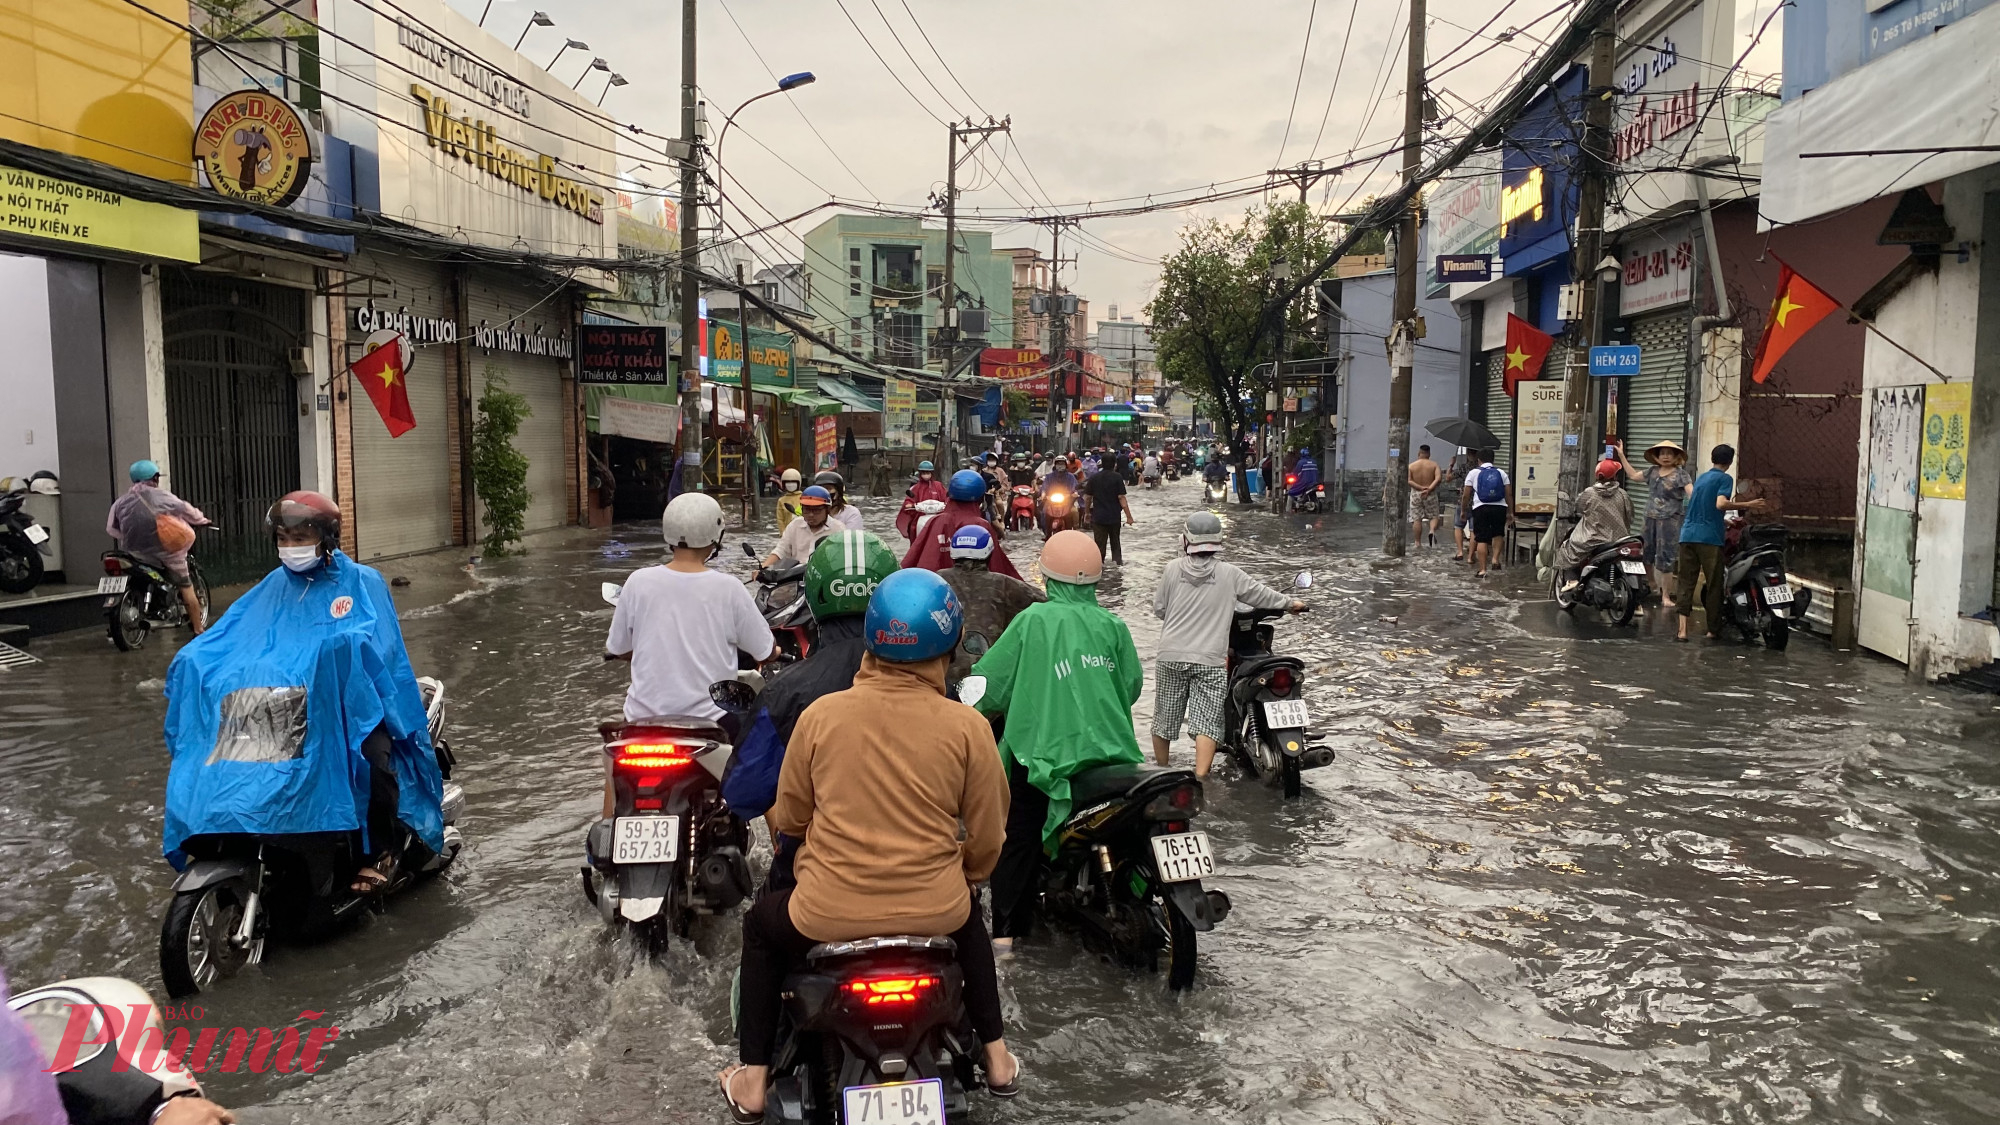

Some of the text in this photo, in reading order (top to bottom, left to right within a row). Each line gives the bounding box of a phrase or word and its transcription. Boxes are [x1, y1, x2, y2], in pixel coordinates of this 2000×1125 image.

[1883, 25, 1899, 42] 265
[477, 119, 538, 193] Home
[539, 153, 603, 216] Decor
[7, 192, 69, 216] NỘI THẤT
[9, 213, 89, 238] PHỤ KIỆN XE
[1443, 260, 1487, 272] Vinamilk
[358, 299, 457, 348] CÀ PHÊ VỊ TƯƠI
[475, 319, 572, 359] NỘI THẤT XUẤT KHẨU
[588, 328, 657, 347] NỘI THẤT
[585, 349, 663, 368] XUẤT KHẨU
[764, 347, 790, 368] XANH
[1595, 352, 1637, 366] HẺM 263
[583, 369, 604, 381] Thiết
[645, 370, 664, 382] Xuất
[1532, 391, 1563, 400] SURE
[830, 578, 880, 597] Grab
[874, 629, 919, 645] Jesus
[1273, 713, 1304, 727] 1889
[625, 820, 669, 839] 59-X3
[619, 840, 672, 859] 657.34
[1161, 834, 1202, 857] 76-E1
[1163, 855, 1213, 880] 117.19
